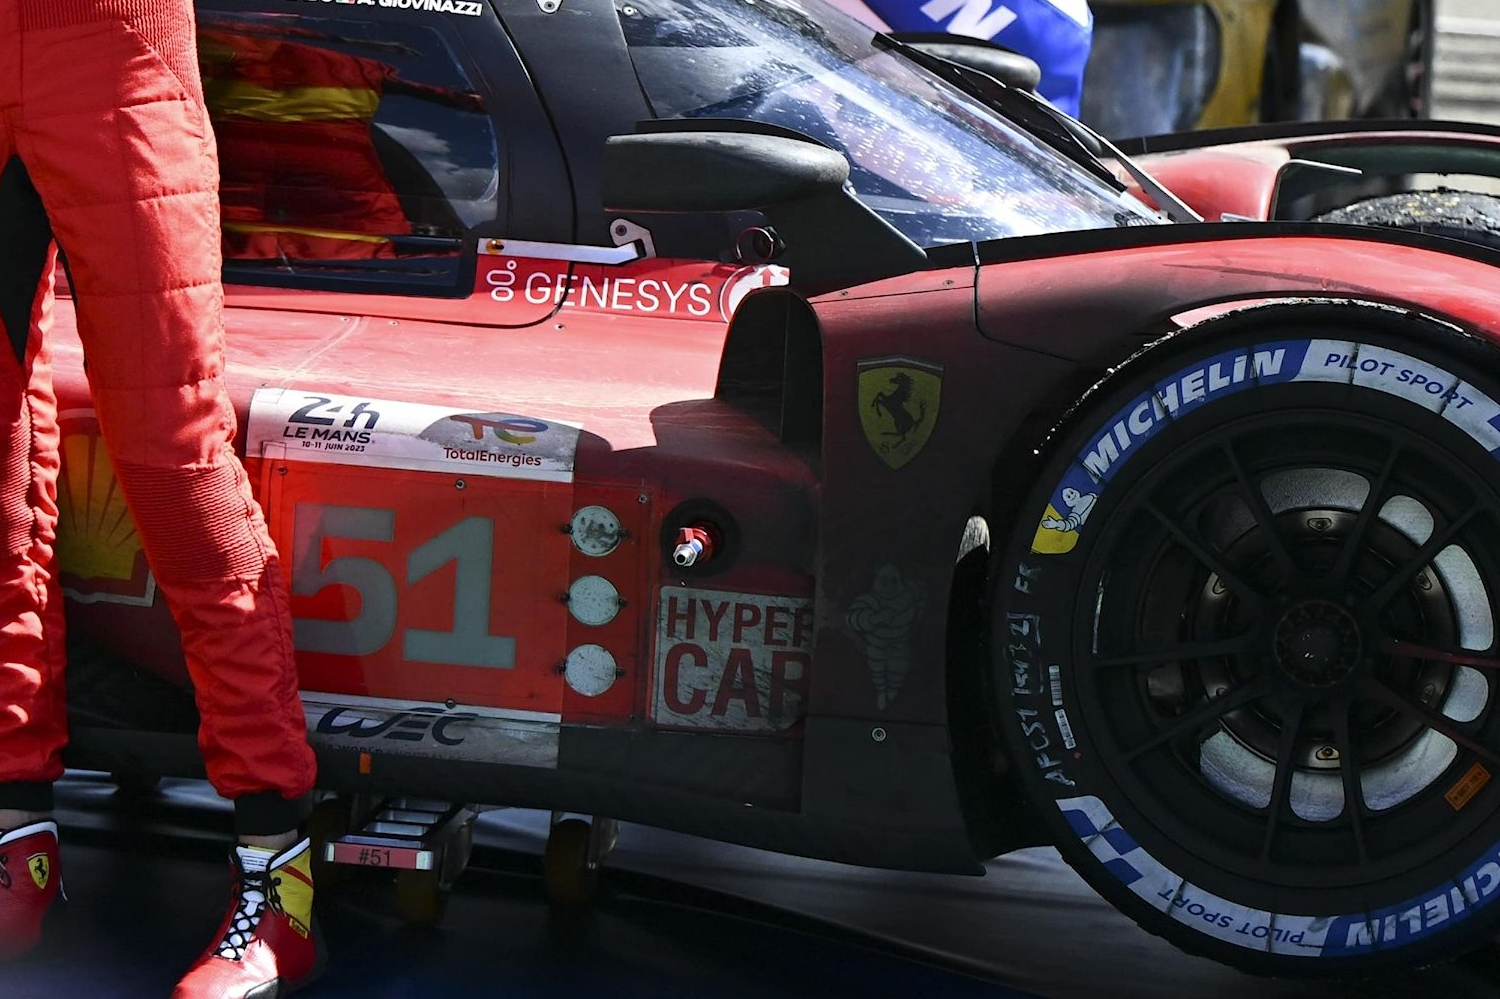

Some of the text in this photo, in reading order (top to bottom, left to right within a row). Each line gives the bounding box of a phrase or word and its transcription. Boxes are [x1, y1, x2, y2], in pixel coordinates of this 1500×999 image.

[524, 271, 712, 316] GENESYS
[1324, 351, 1474, 412] PILOT SPORT
[283, 425, 373, 444] LE MANS
[1081, 347, 1287, 480] MICHELIN
[301, 439, 365, 452] 10-11 JUIN 2023
[443, 446, 542, 467] TotalEnergies
[292, 503, 517, 670] 51
[315, 706, 480, 746] WEC
[358, 848, 392, 867] #51
[1157, 887, 1306, 945] PILOT SPORT
[1345, 857, 1500, 949] CHELIN
